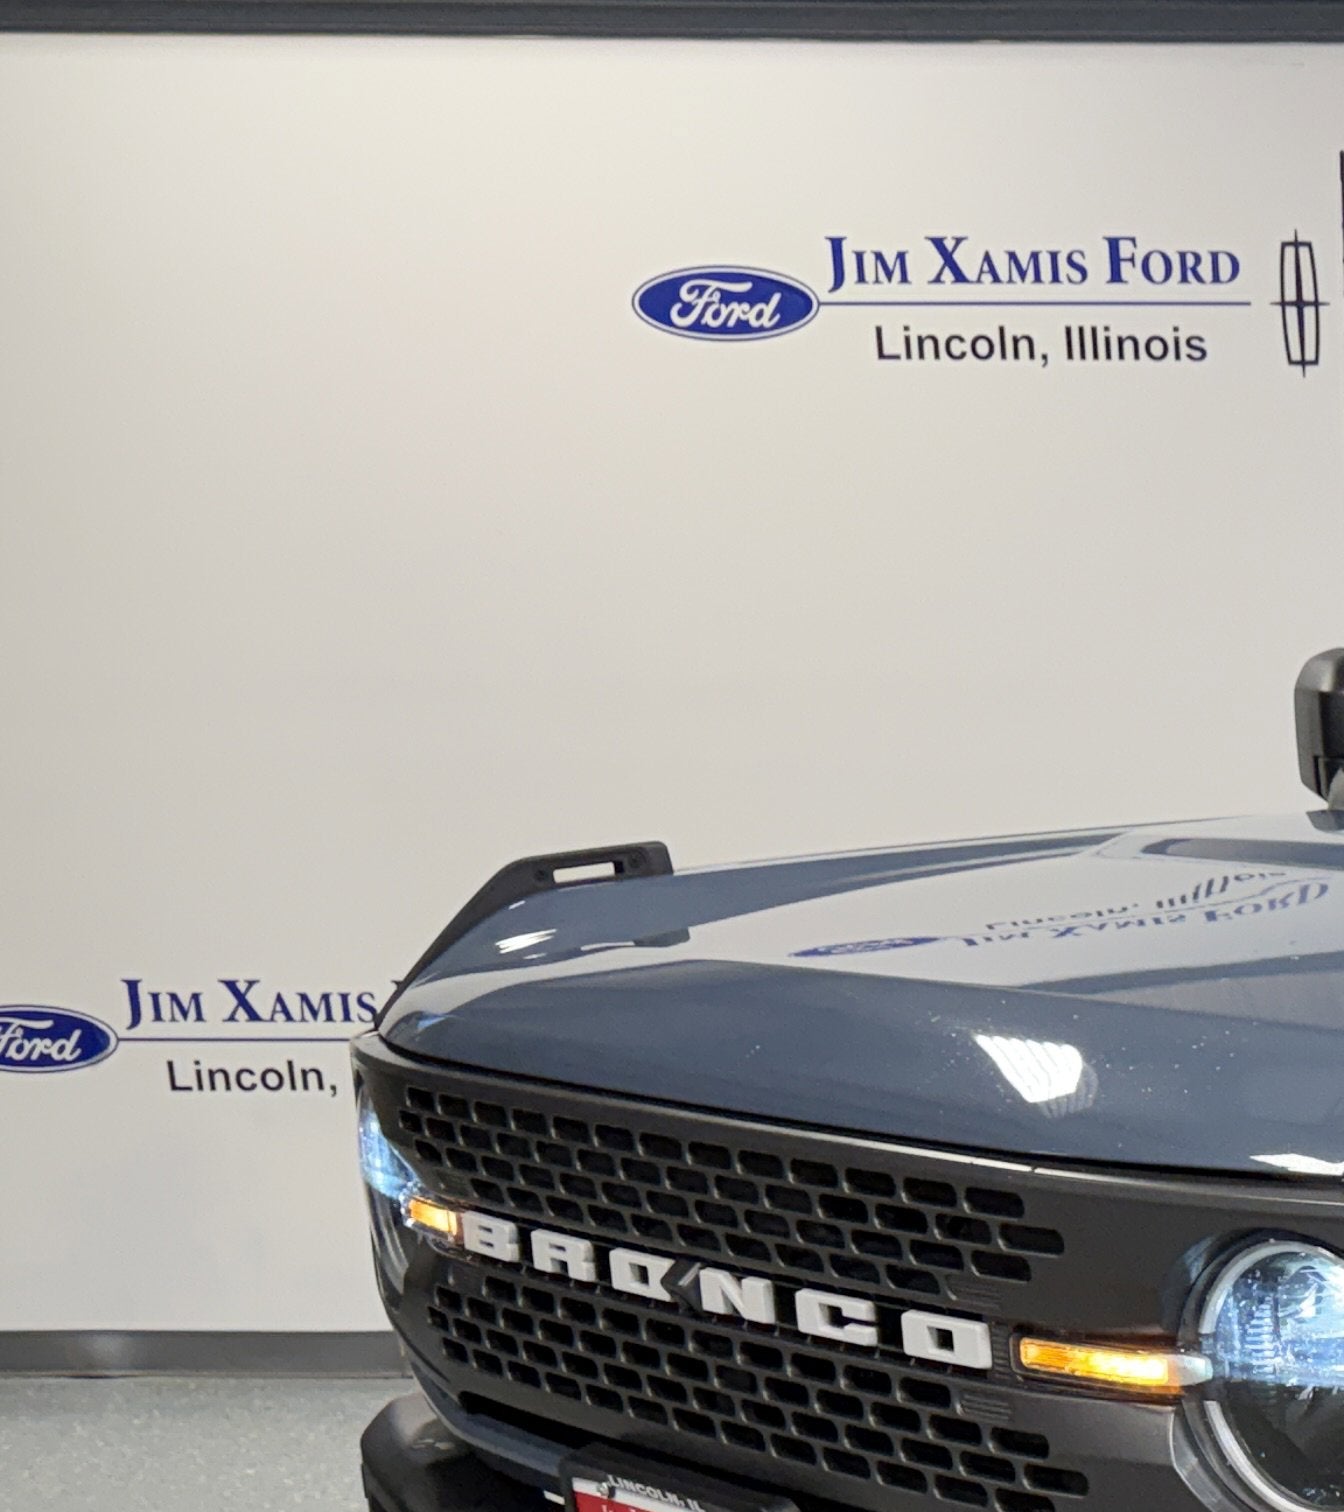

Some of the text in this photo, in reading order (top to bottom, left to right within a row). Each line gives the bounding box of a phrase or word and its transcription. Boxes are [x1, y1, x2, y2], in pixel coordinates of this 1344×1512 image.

[825, 236, 1241, 293] JIM XAMIS FORD
[669, 280, 781, 329] Ford
[875, 326, 1208, 367] Lincoln, Illinois
[121, 979, 205, 1030] JIM
[217, 979, 377, 1024] XAMIS
[167, 1060, 338, 1097] Lincoln,
[461, 1209, 993, 1370] BRONCO
